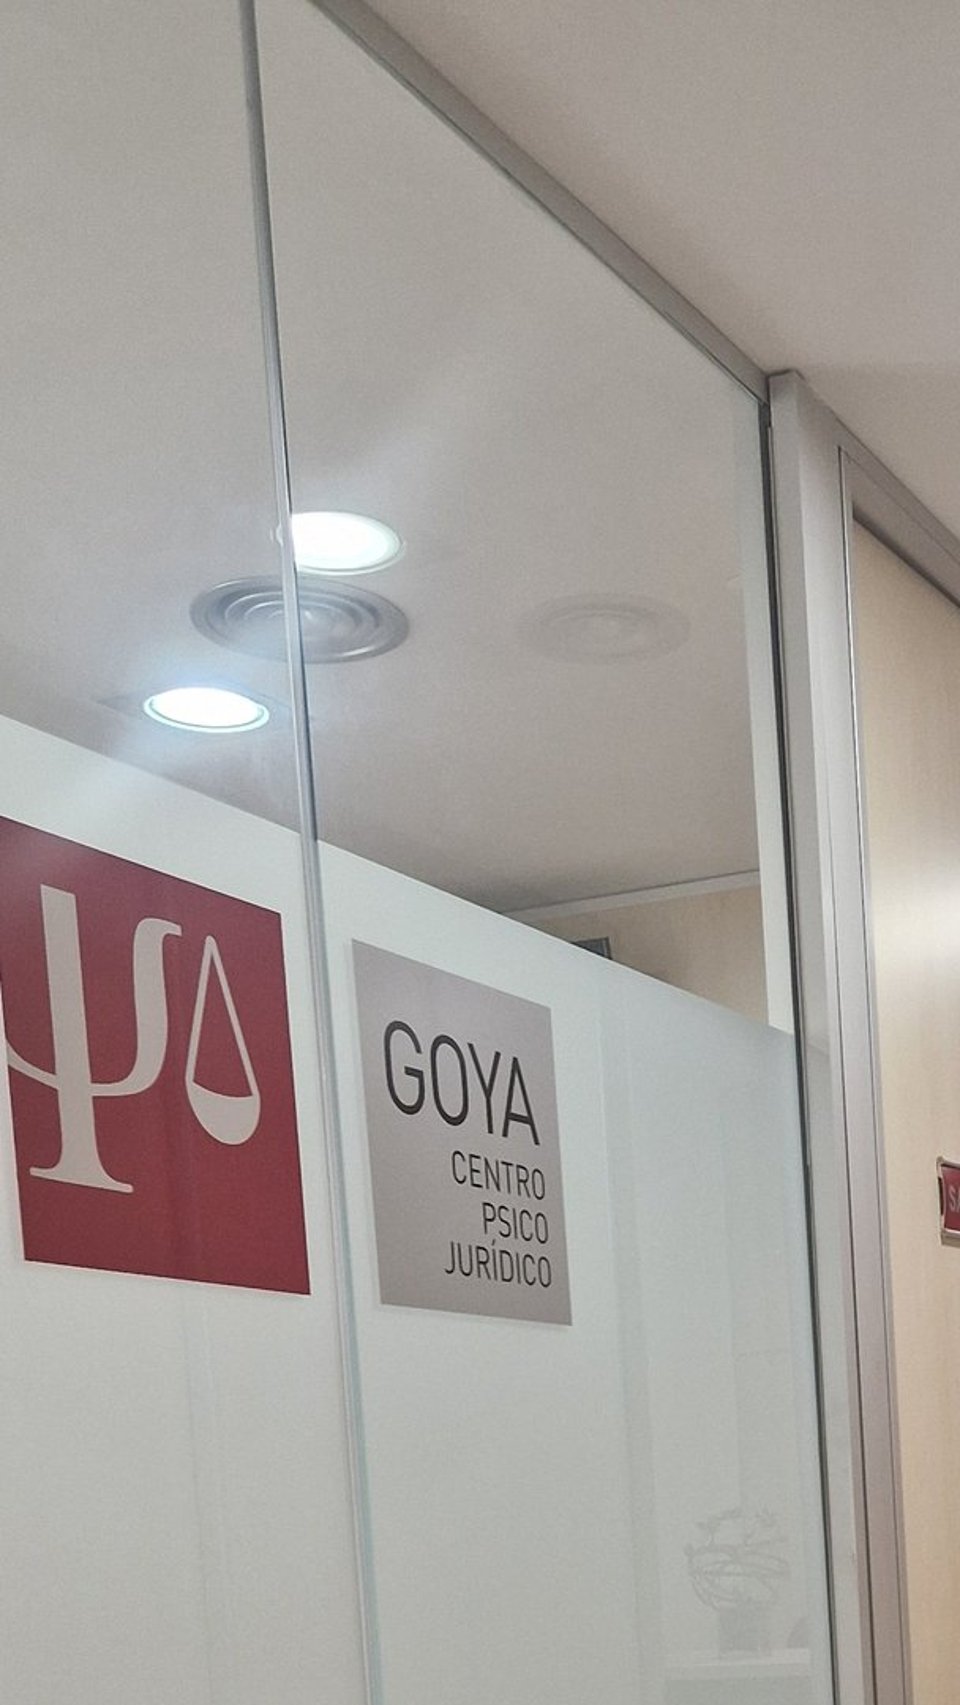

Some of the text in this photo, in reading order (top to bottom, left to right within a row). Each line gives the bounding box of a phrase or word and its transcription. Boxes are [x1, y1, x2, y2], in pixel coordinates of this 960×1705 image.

[383, 1020, 541, 1146] GOYA
[450, 1150, 546, 1200] CENTRO
[482, 1202, 549, 1244] PSICO
[444, 1240, 552, 1289] JURÍDICO
